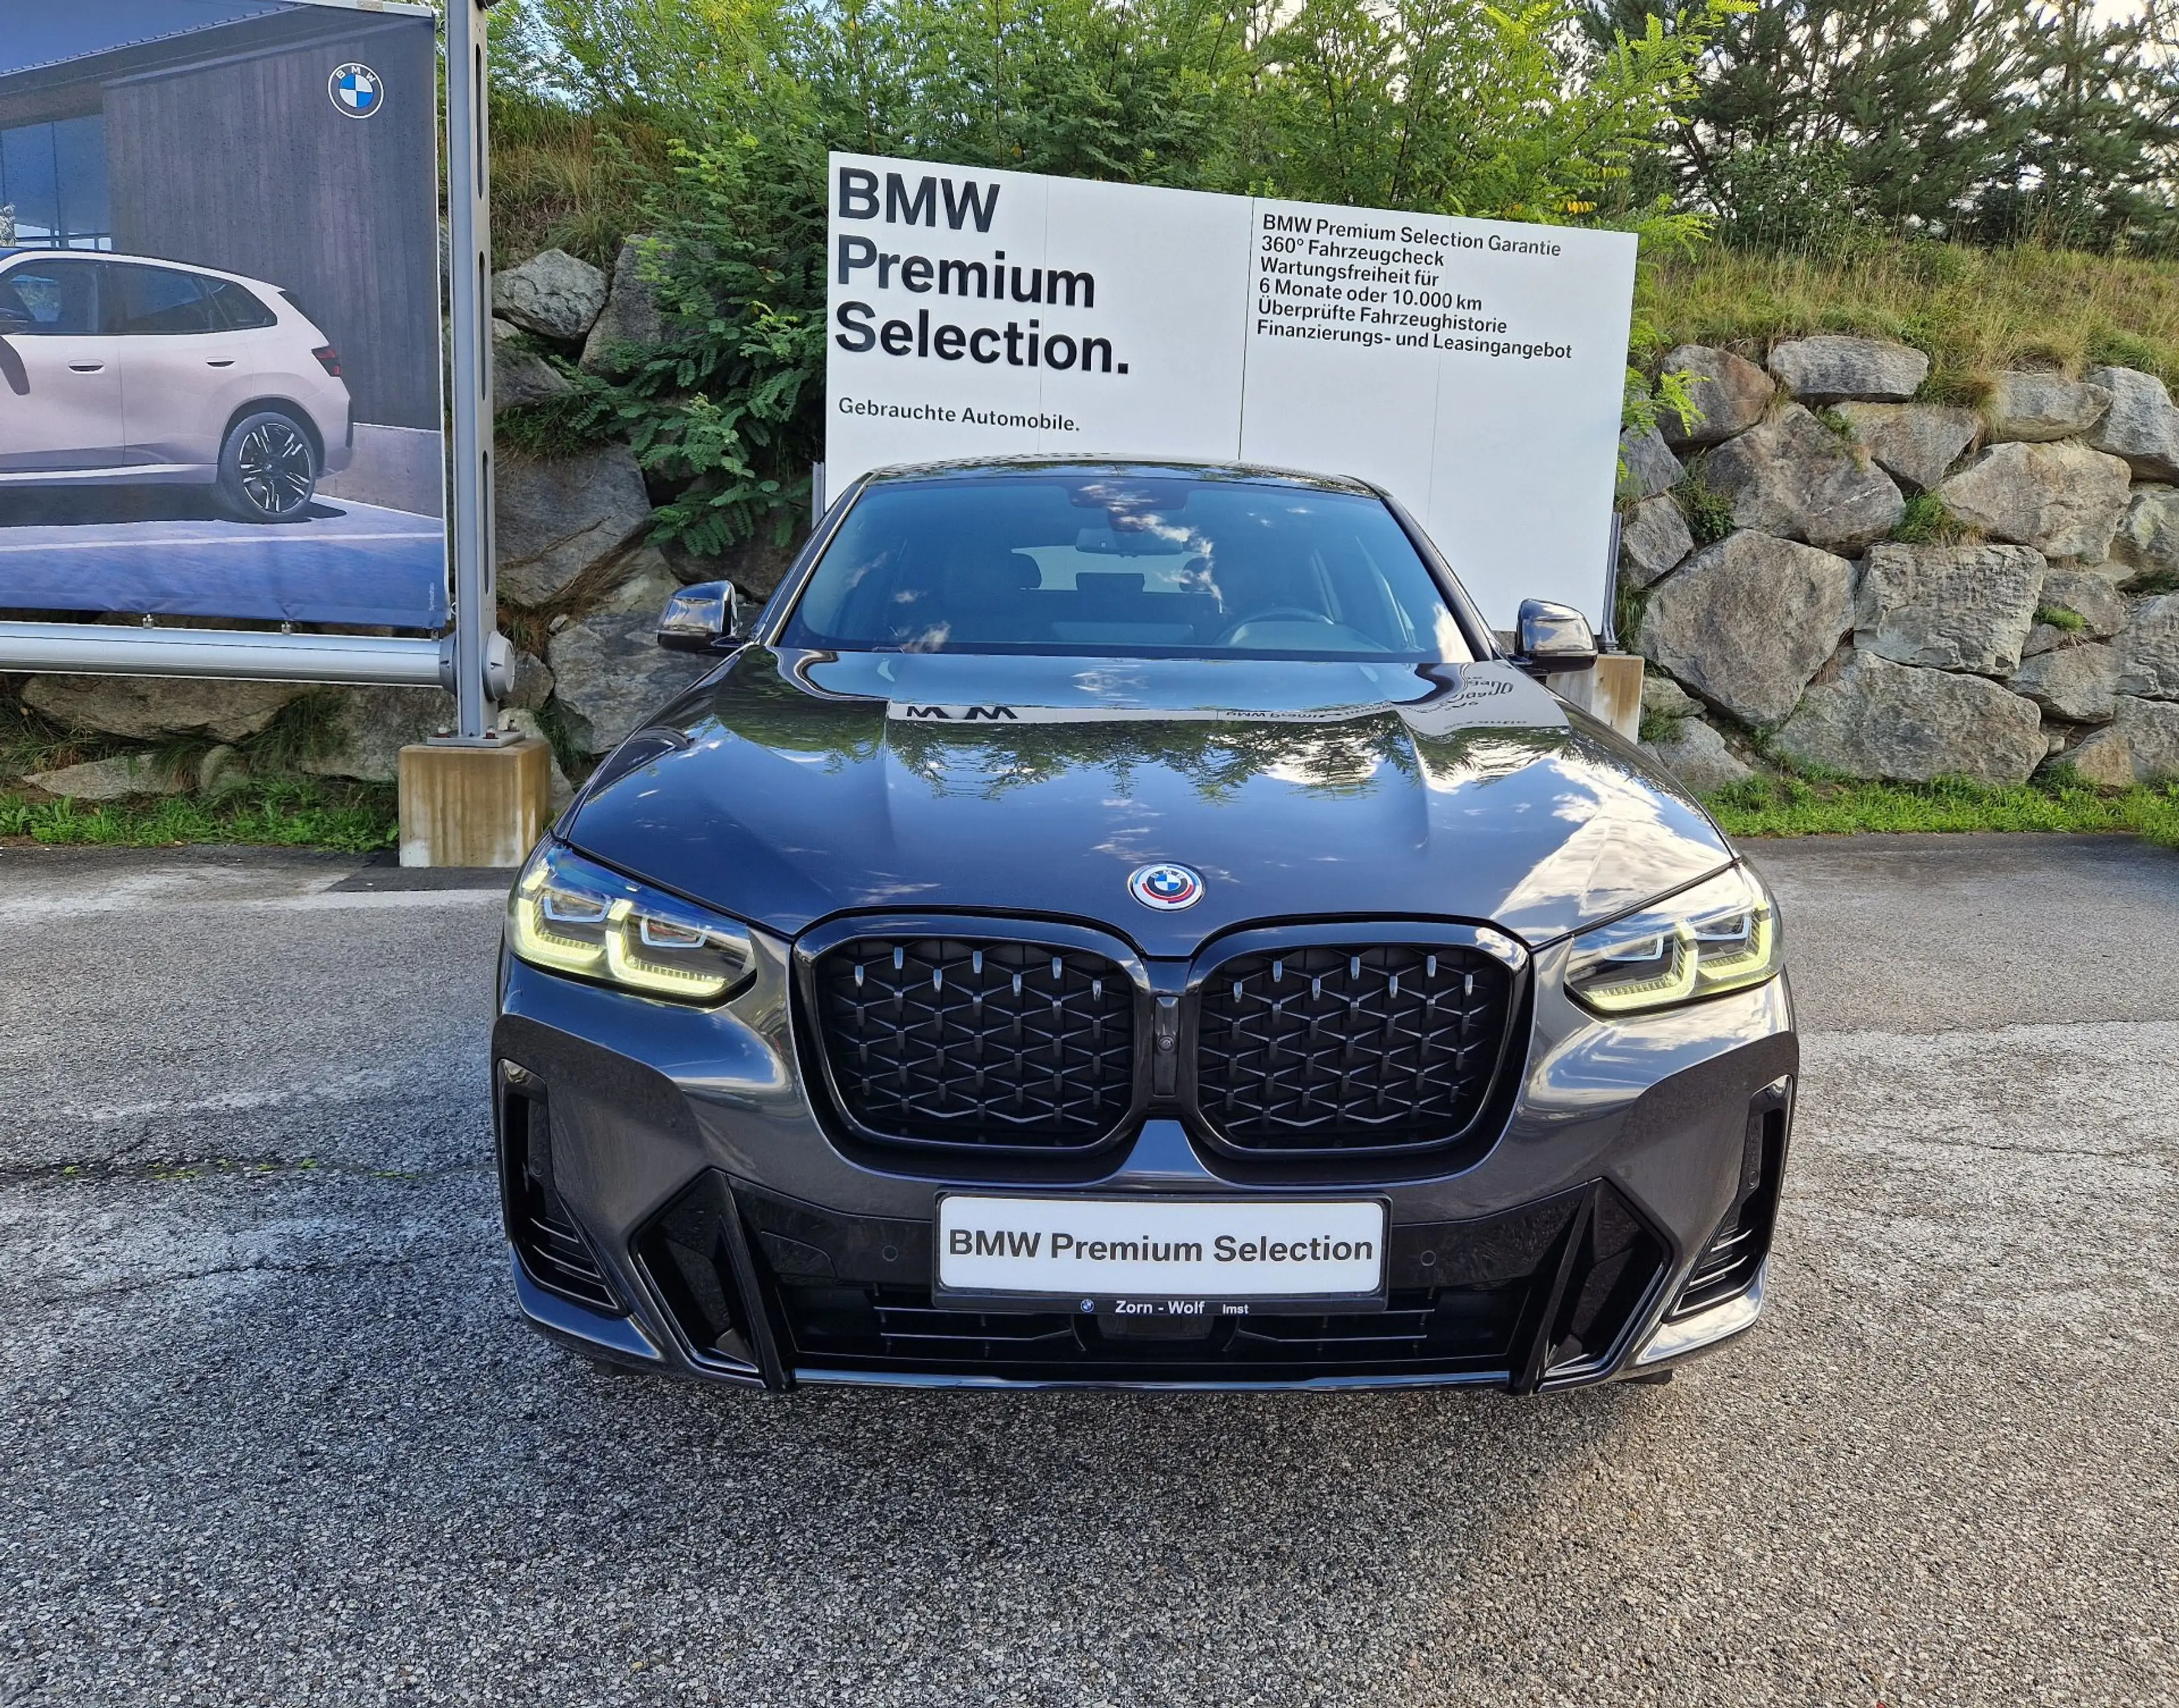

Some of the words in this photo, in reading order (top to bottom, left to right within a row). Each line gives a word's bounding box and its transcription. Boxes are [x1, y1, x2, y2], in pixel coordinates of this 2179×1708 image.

[336, 66, 375, 82] BMW
[838, 167, 1001, 233] BMW
[1261, 235, 1304, 254] 360°
[1308, 239, 1444, 266] Fahrzeugcheck
[1263, 213, 1313, 234] BMW
[1316, 219, 1396, 242] Premium
[1400, 227, 1483, 250] Selection
[1488, 235, 1561, 257] Garantie
[837, 234, 1095, 308] Premium
[1260, 256, 1410, 285] Wartungsfreiheit
[1414, 269, 1439, 287] für
[1259, 277, 1270, 294] 6
[1275, 278, 1343, 300] Monate
[1346, 286, 1388, 303] oder
[1393, 289, 1452, 308] 10.000
[1456, 294, 1482, 311] km
[1258, 294, 1356, 321] Überprüfte
[1360, 306, 1507, 334] Fahrzeughistorie
[835, 301, 1129, 375] Selection.
[1257, 318, 1391, 347] Finanzierungs-
[1396, 332, 1429, 348] und
[1433, 333, 1572, 359] Leasingangebot
[839, 397, 956, 422] Gebrauchte
[961, 407, 1079, 432] Automobile.
[949, 1229, 1041, 1258] BMW
[1051, 1232, 1202, 1262] Premium
[1213, 1235, 1373, 1262] Selection
[1115, 1300, 1153, 1314] Zorn
[1167, 1300, 1205, 1314] Wolf
[1222, 1304, 1250, 1314] Imst
